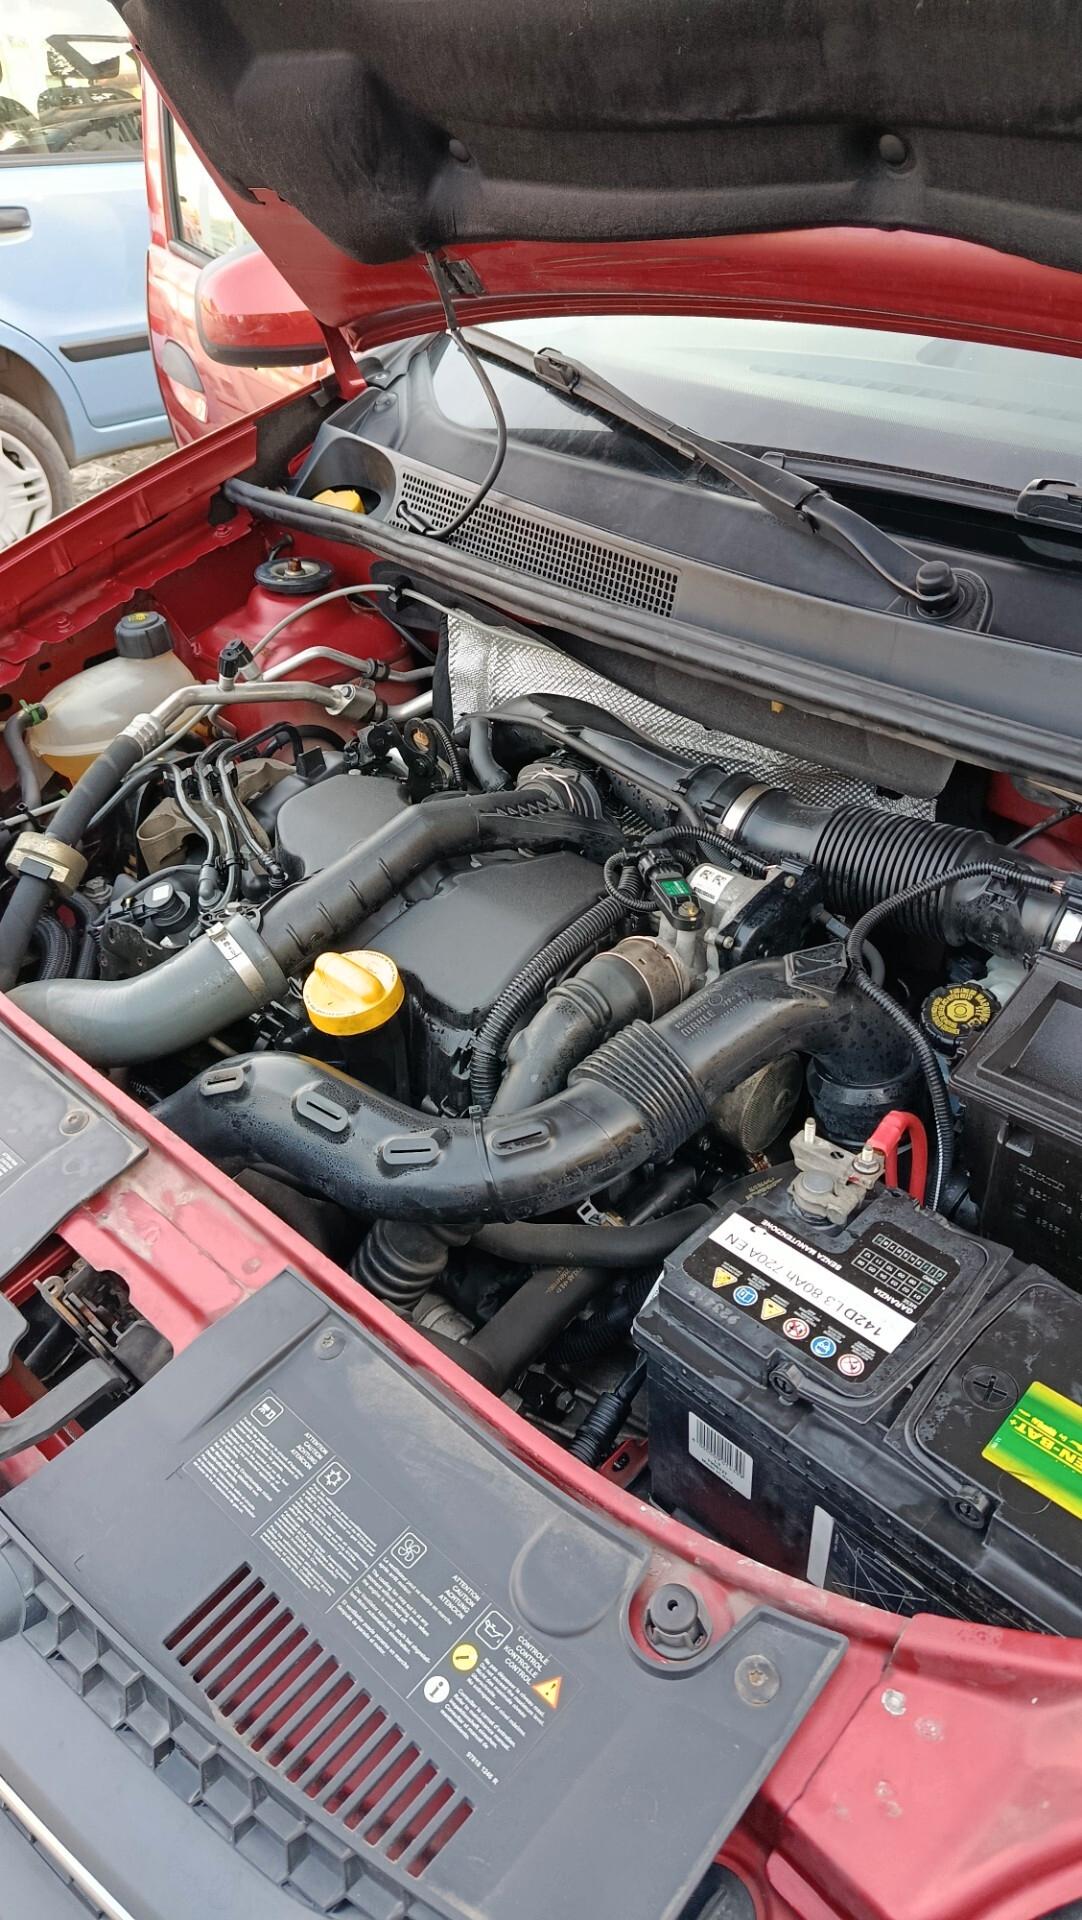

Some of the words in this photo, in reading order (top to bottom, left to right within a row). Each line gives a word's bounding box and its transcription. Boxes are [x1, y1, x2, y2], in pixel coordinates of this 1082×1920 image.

[724, 1231, 748, 1251] EN
[760, 1217, 818, 1256] MANUTENZIONE
[748, 1246, 784, 1275] 720A
[816, 1251, 841, 1271] SENZA
[784, 1268, 823, 1300] 80Ah
[912, 1292, 921, 1300] 01
[823, 1293, 844, 1313] L3
[872, 1286, 914, 1315] GARANZIA
[842, 1306, 883, 1337] 142D
[302, 1440, 323, 1460] CAUTION
[303, 1431, 328, 1455] ATTENTION
[443, 1588, 470, 1613] ACHTUNG
[451, 1573, 481, 1602] ATTENTION
[451, 1584, 475, 1607] CAUTION
[502, 1644, 538, 1678] KONTROLLE
[514, 1644, 544, 1672] CONTROL
[517, 1635, 549, 1665] CONTROLE
[503, 1657, 533, 1685] CONTROL
